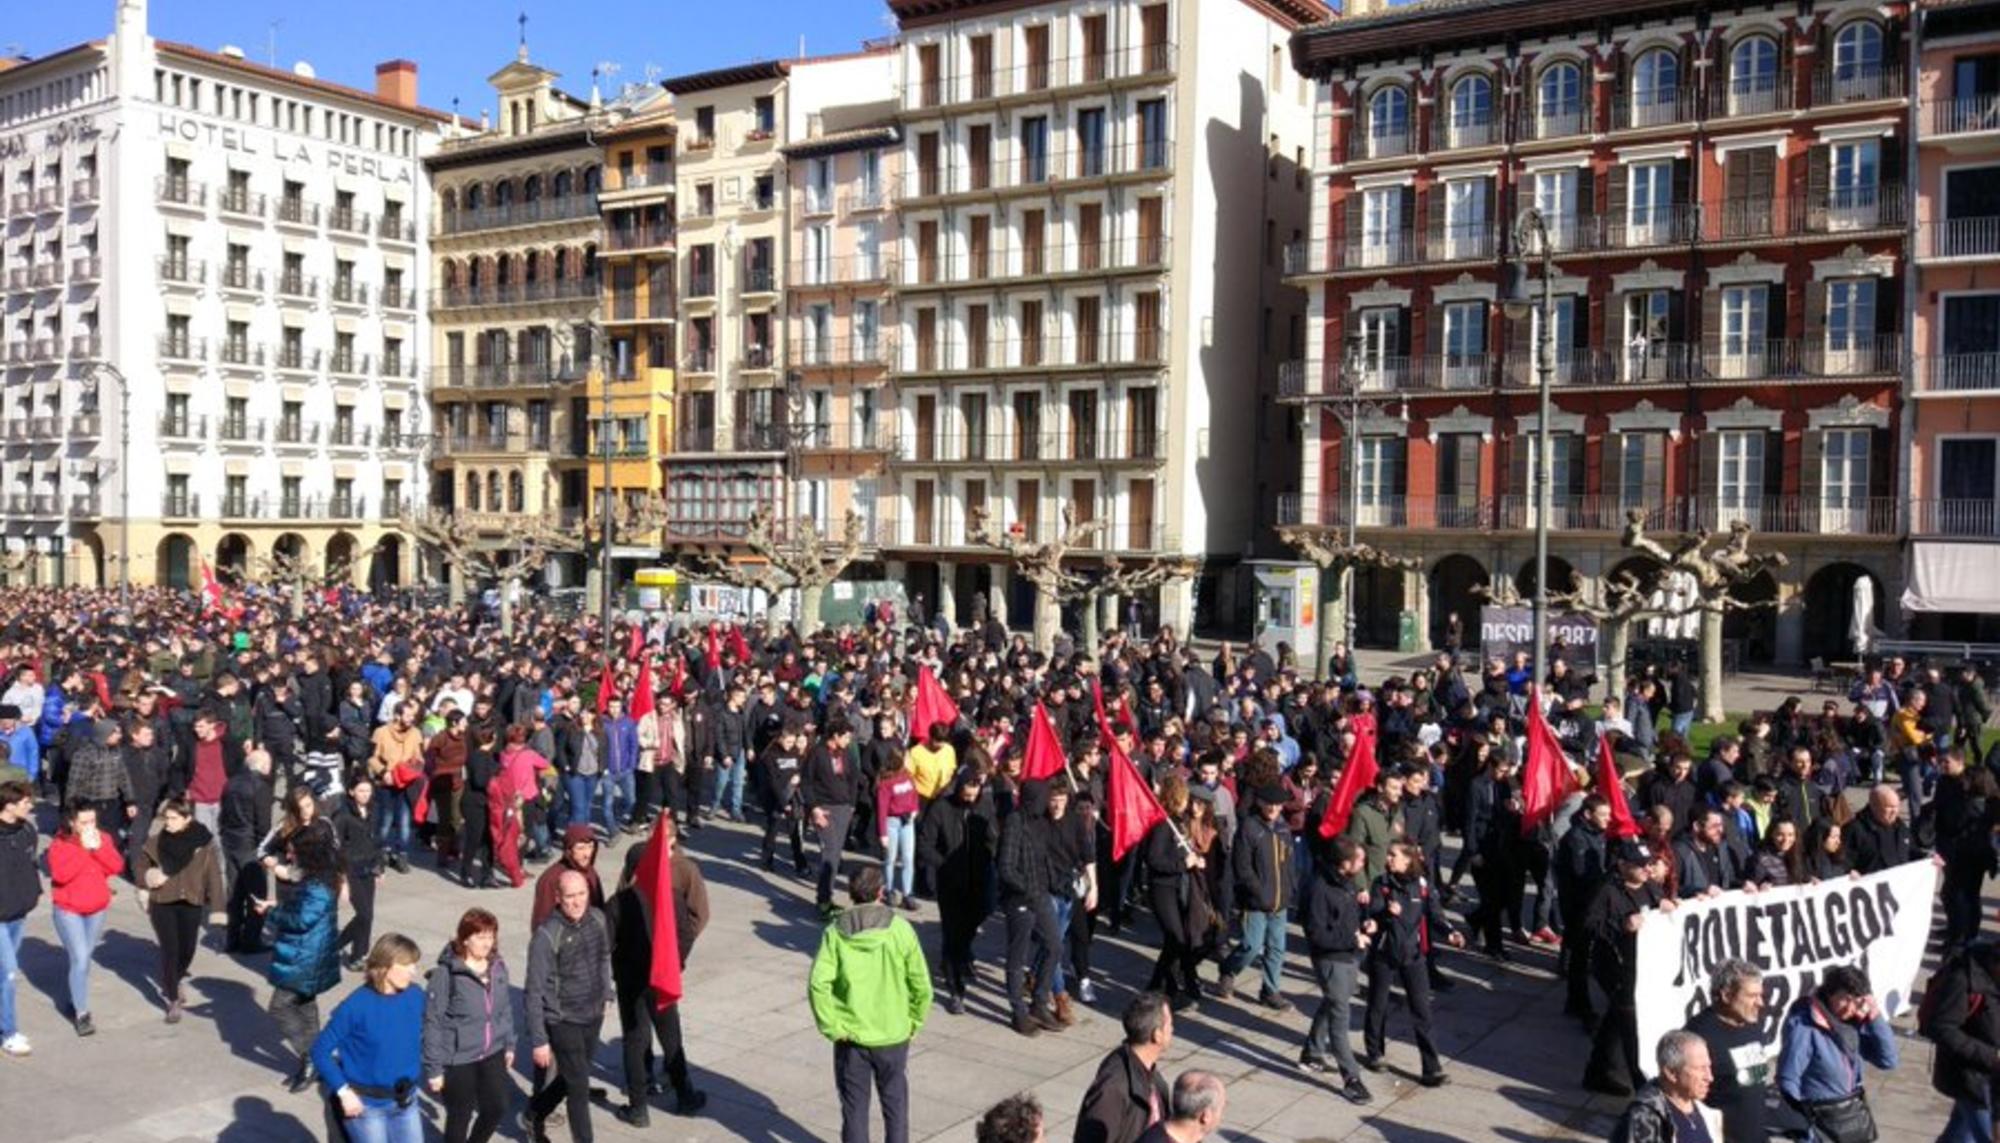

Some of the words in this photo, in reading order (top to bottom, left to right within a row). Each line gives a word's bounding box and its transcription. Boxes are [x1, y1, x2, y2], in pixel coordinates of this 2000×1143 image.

[158, 112, 256, 155] HOTEL
[273, 138, 312, 164] LA
[327, 150, 412, 184] PERLA
